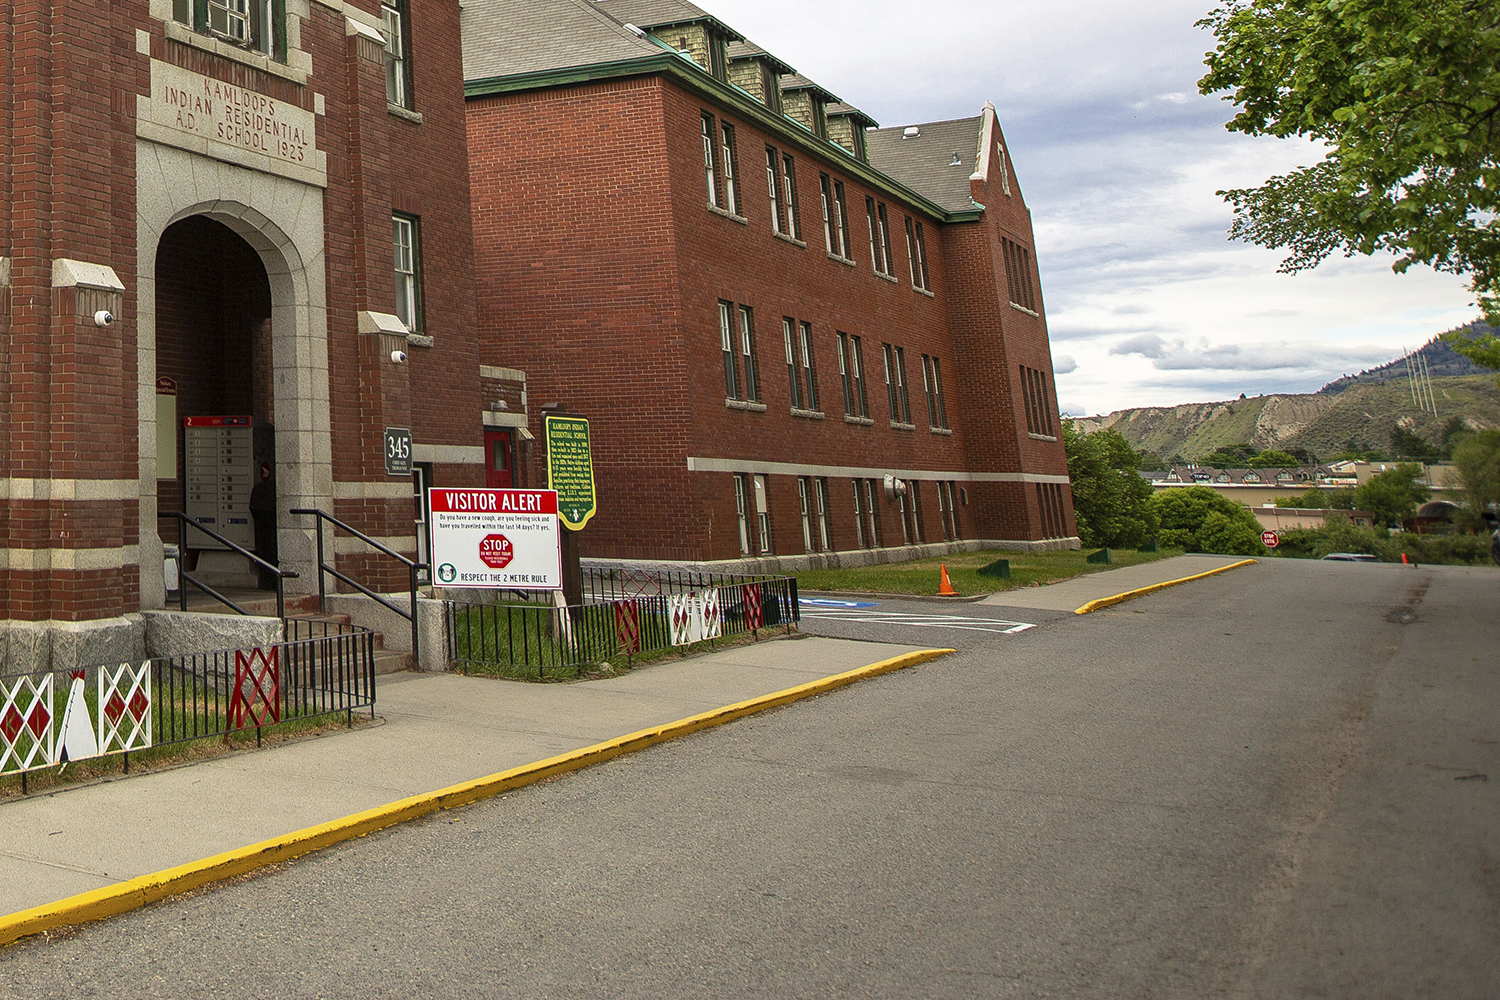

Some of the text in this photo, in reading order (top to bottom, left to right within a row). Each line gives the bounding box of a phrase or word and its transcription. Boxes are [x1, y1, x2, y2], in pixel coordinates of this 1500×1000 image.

[204, 79, 275, 116] KAMLOOPS
[165, 86, 308, 146] INDIAN RESIDENTIAL
[176, 110, 304, 162] A.D. SCHOOL 1923
[187, 418, 192, 426] 2
[388, 436, 409, 458] 345
[446, 492, 542, 511] VISITOR ALERT
[483, 540, 508, 550] STOP
[461, 573, 487, 581] RESPECT
[510, 574, 529, 582] METRE
[531, 575, 547, 583] RULE
[5, 713, 16, 736] K
